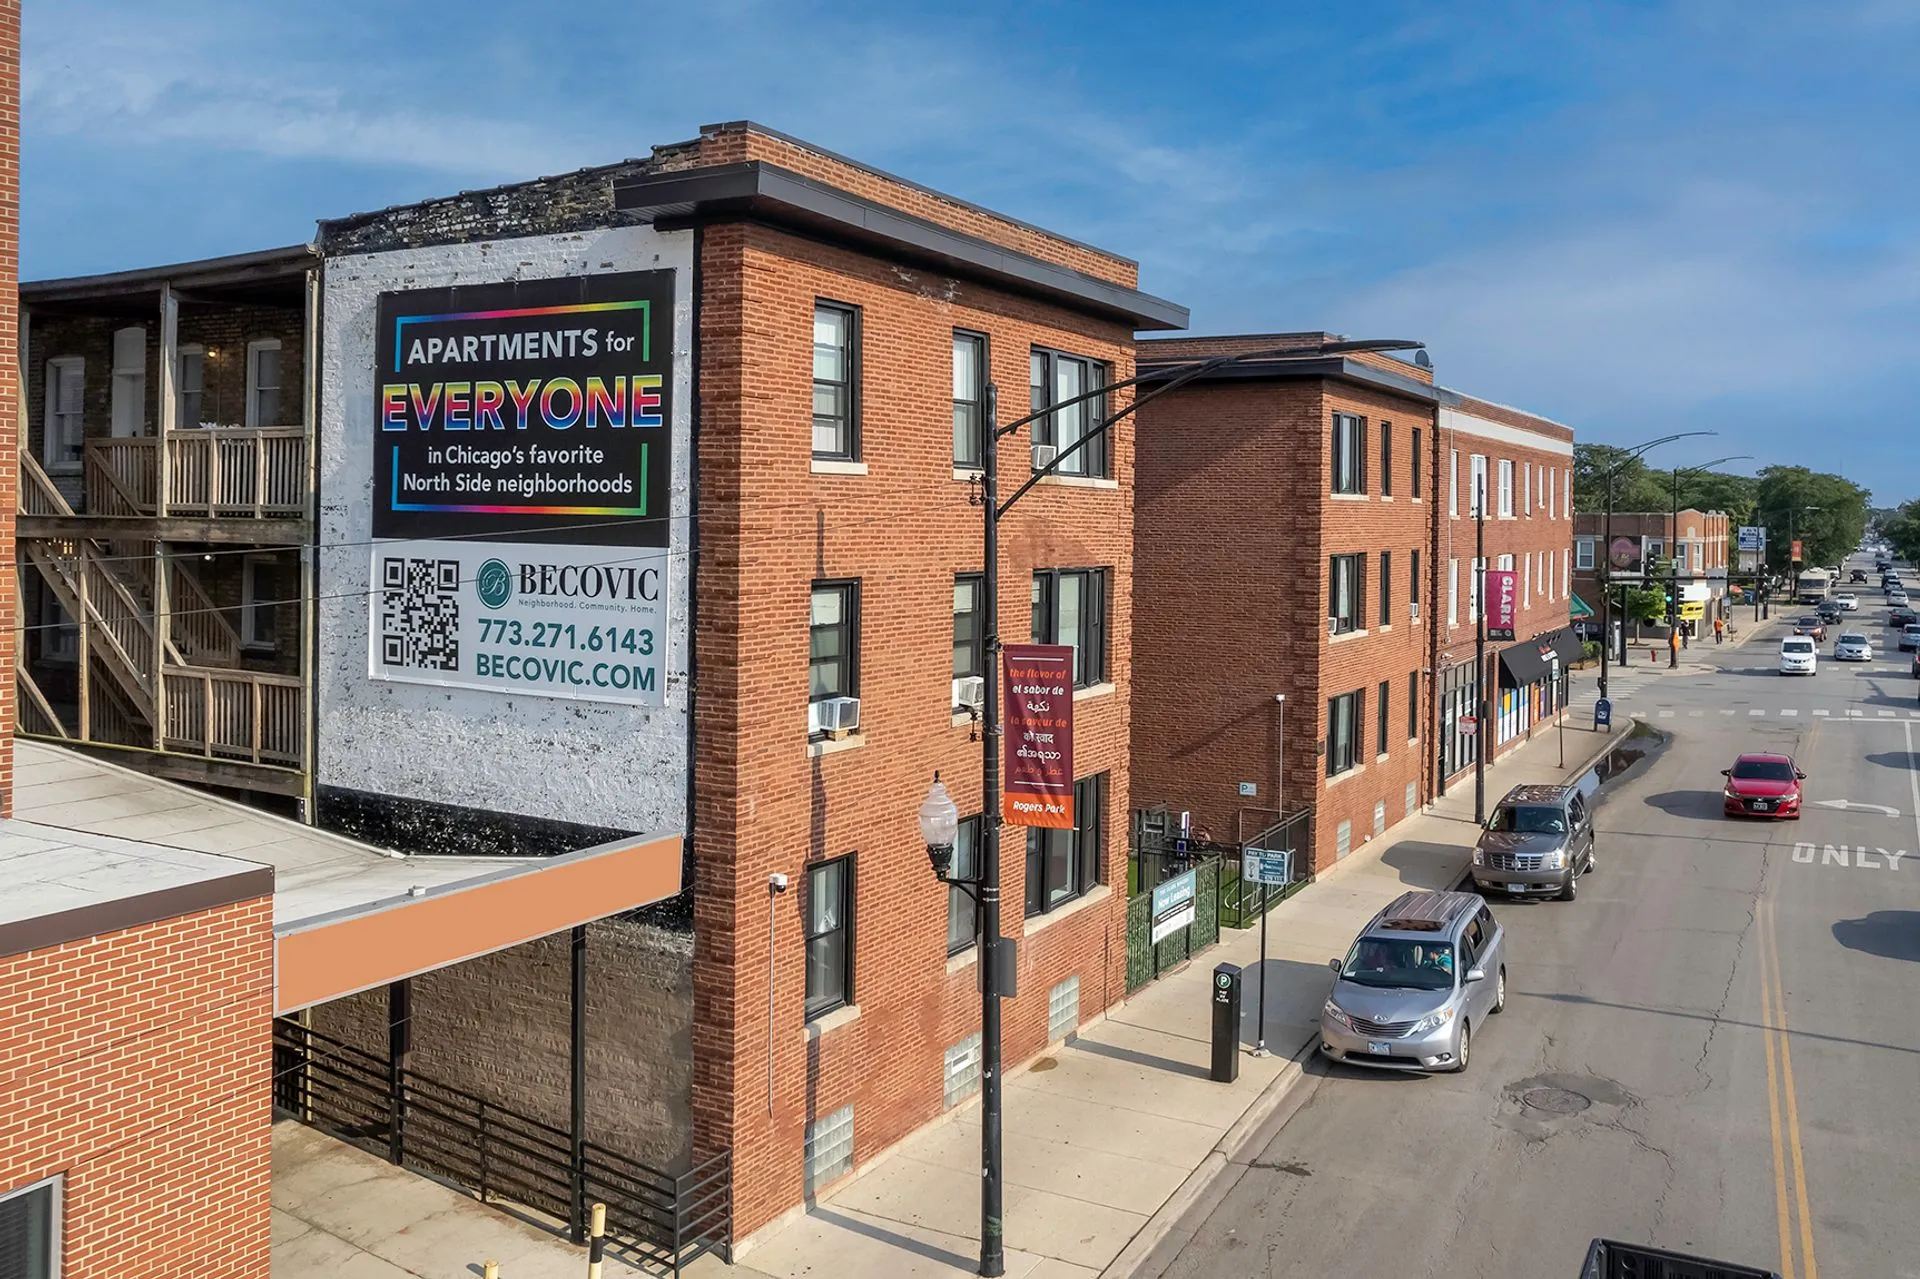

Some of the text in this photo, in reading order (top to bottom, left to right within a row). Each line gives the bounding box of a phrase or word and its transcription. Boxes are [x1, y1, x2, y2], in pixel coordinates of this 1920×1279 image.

[407, 328, 635, 364] APARTMENTS for
[381, 374, 663, 431] EVERYONE
[428, 444, 604, 469] in Chicago's favorite
[403, 473, 633, 498] North Side neighborhoods
[518, 564, 659, 601] BECOVIC
[518, 599, 657, 615] Neighborhood. Community. Home.
[1500, 576, 1514, 625] CLARK
[478, 618, 655, 656] 773.271.6143
[476, 653, 656, 692] BECOVIC.COM
[1009, 668, 1067, 680] the flavor of
[1012, 684, 1064, 696] el sabor de
[1055, 717, 1068, 728] de
[1013, 800, 1065, 814] Rogers Park
[1791, 842, 1907, 871] ONLY
